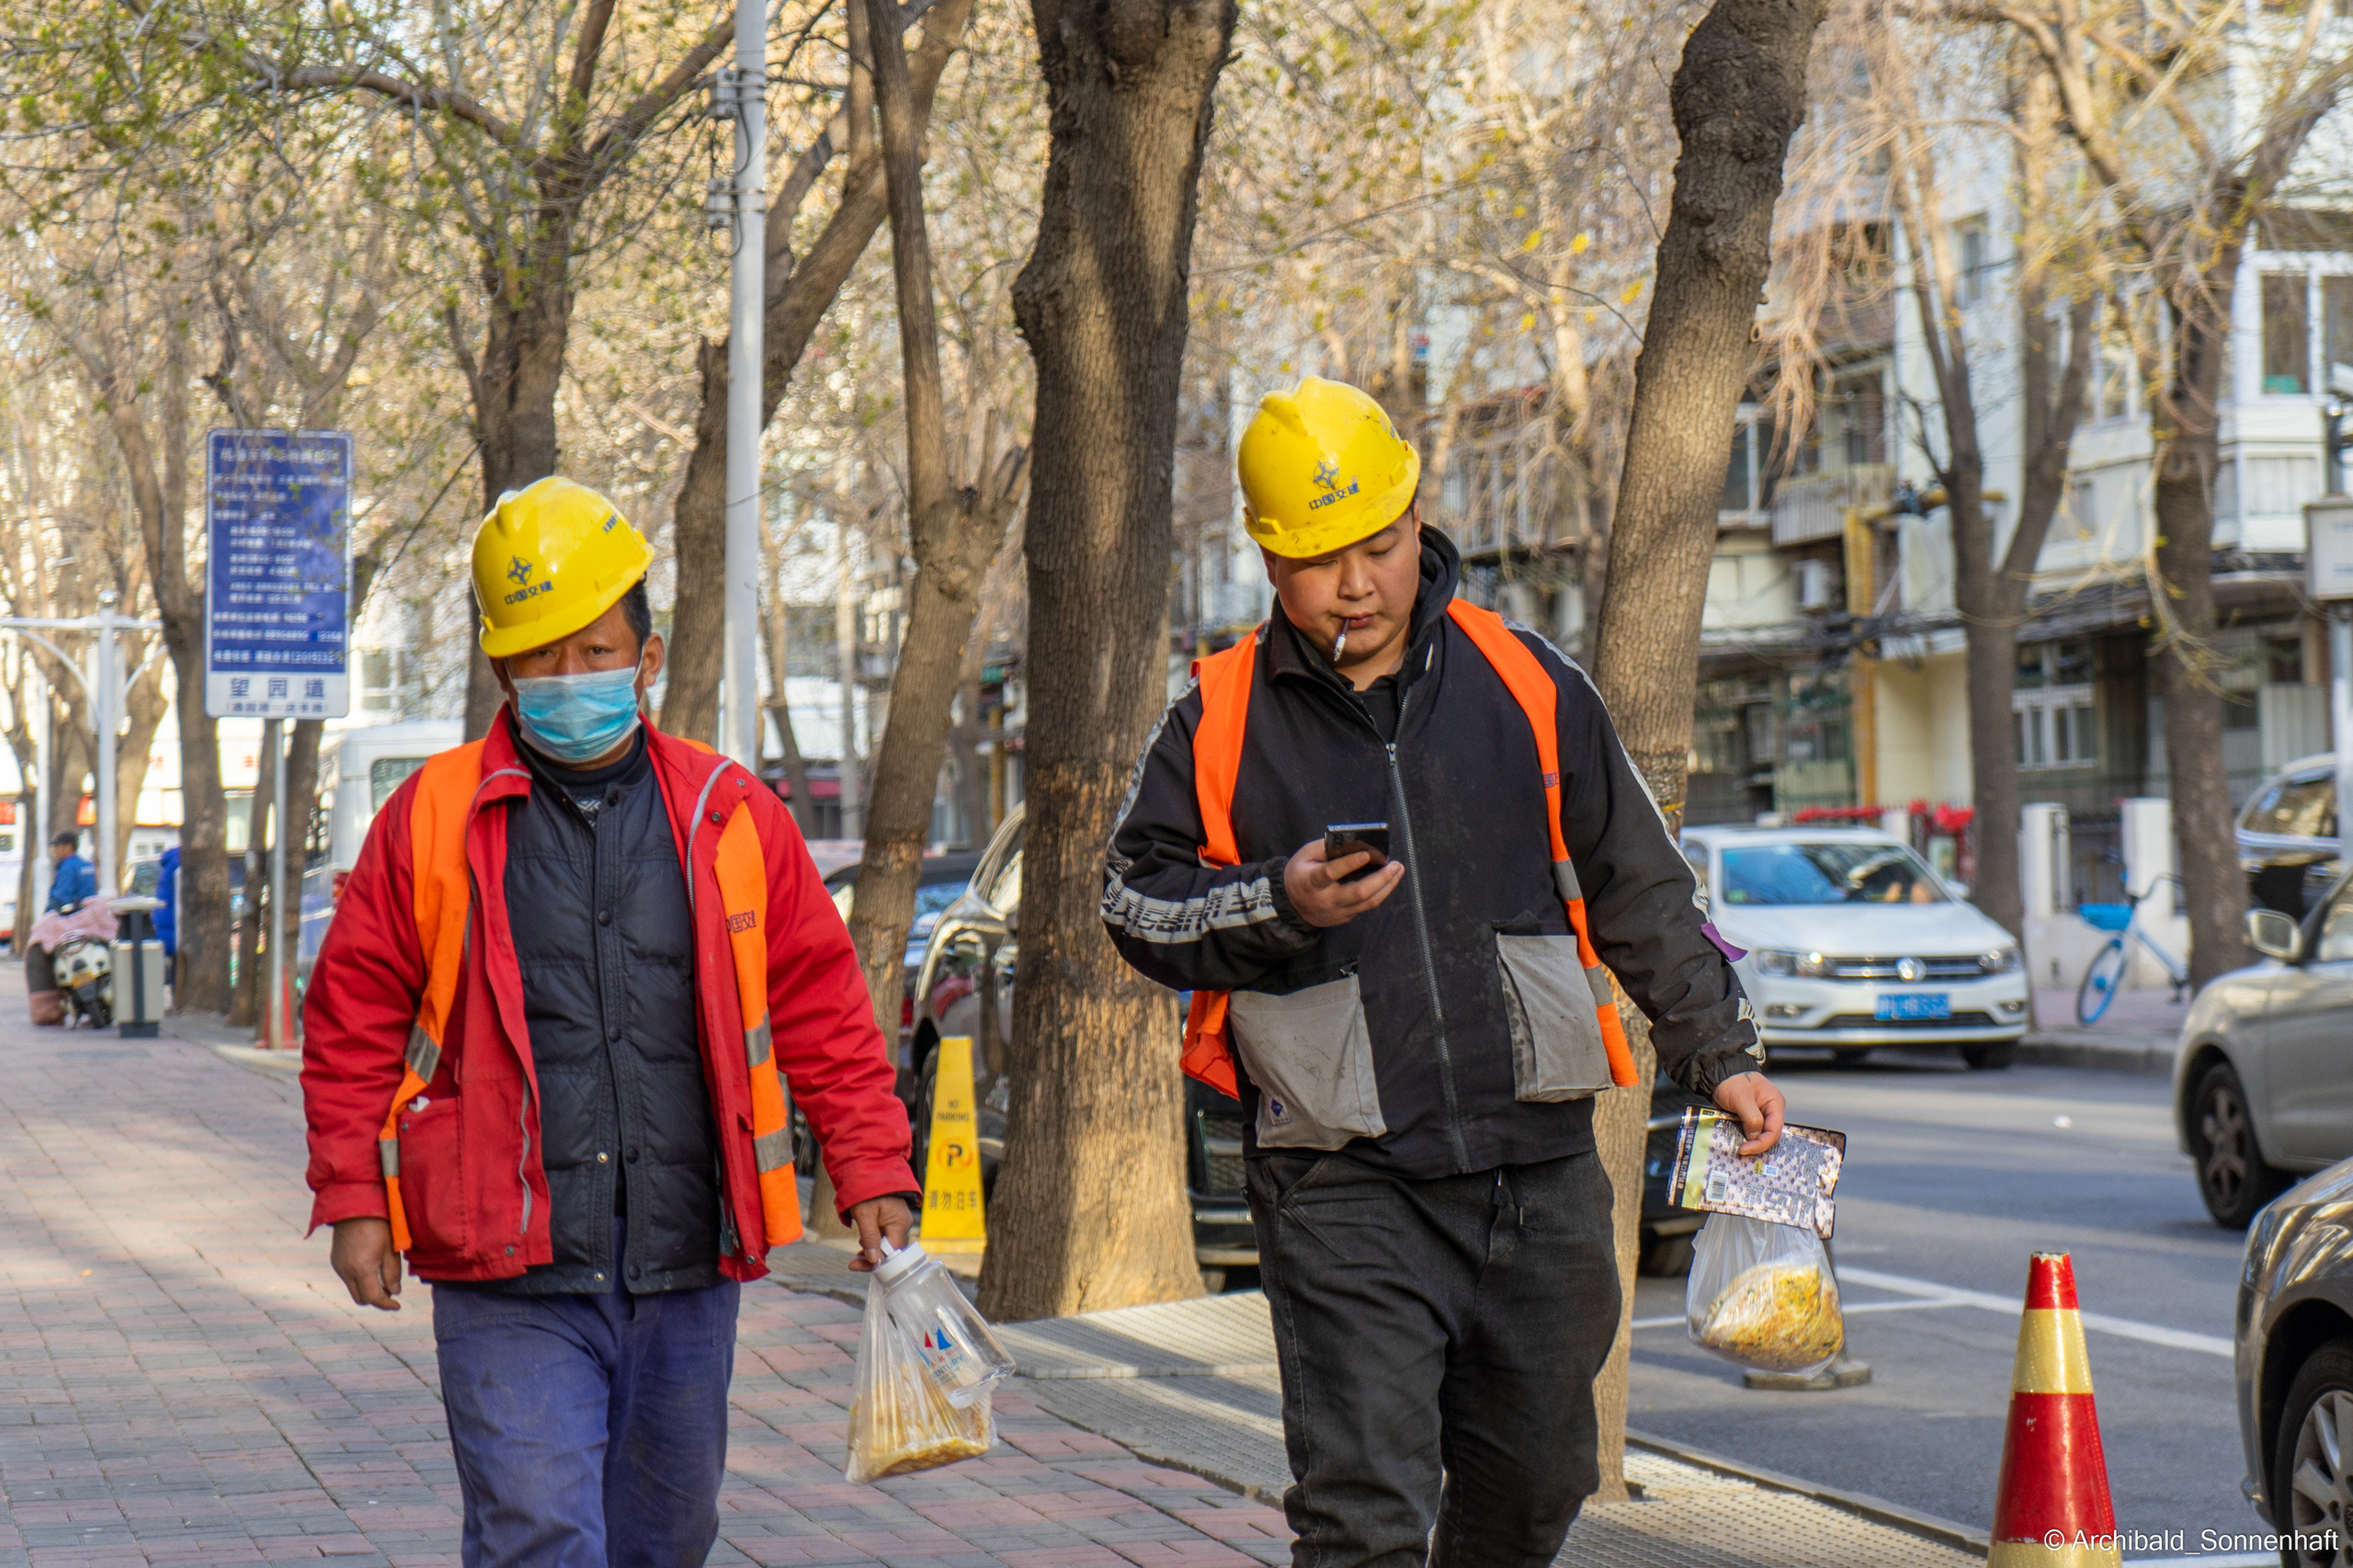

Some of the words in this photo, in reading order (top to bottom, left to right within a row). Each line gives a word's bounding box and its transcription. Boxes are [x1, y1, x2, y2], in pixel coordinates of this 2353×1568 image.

[1309, 483, 1361, 510] 中国交建
[504, 580, 553, 605] 中国交建
[231, 677, 325, 699] 望园道
[948, 1099, 959, 1108] NO
[936, 1112, 970, 1122] PARKING
[927, 1189, 977, 1210] 请勿泊车
[933, 1354, 965, 1378] ENTURY
